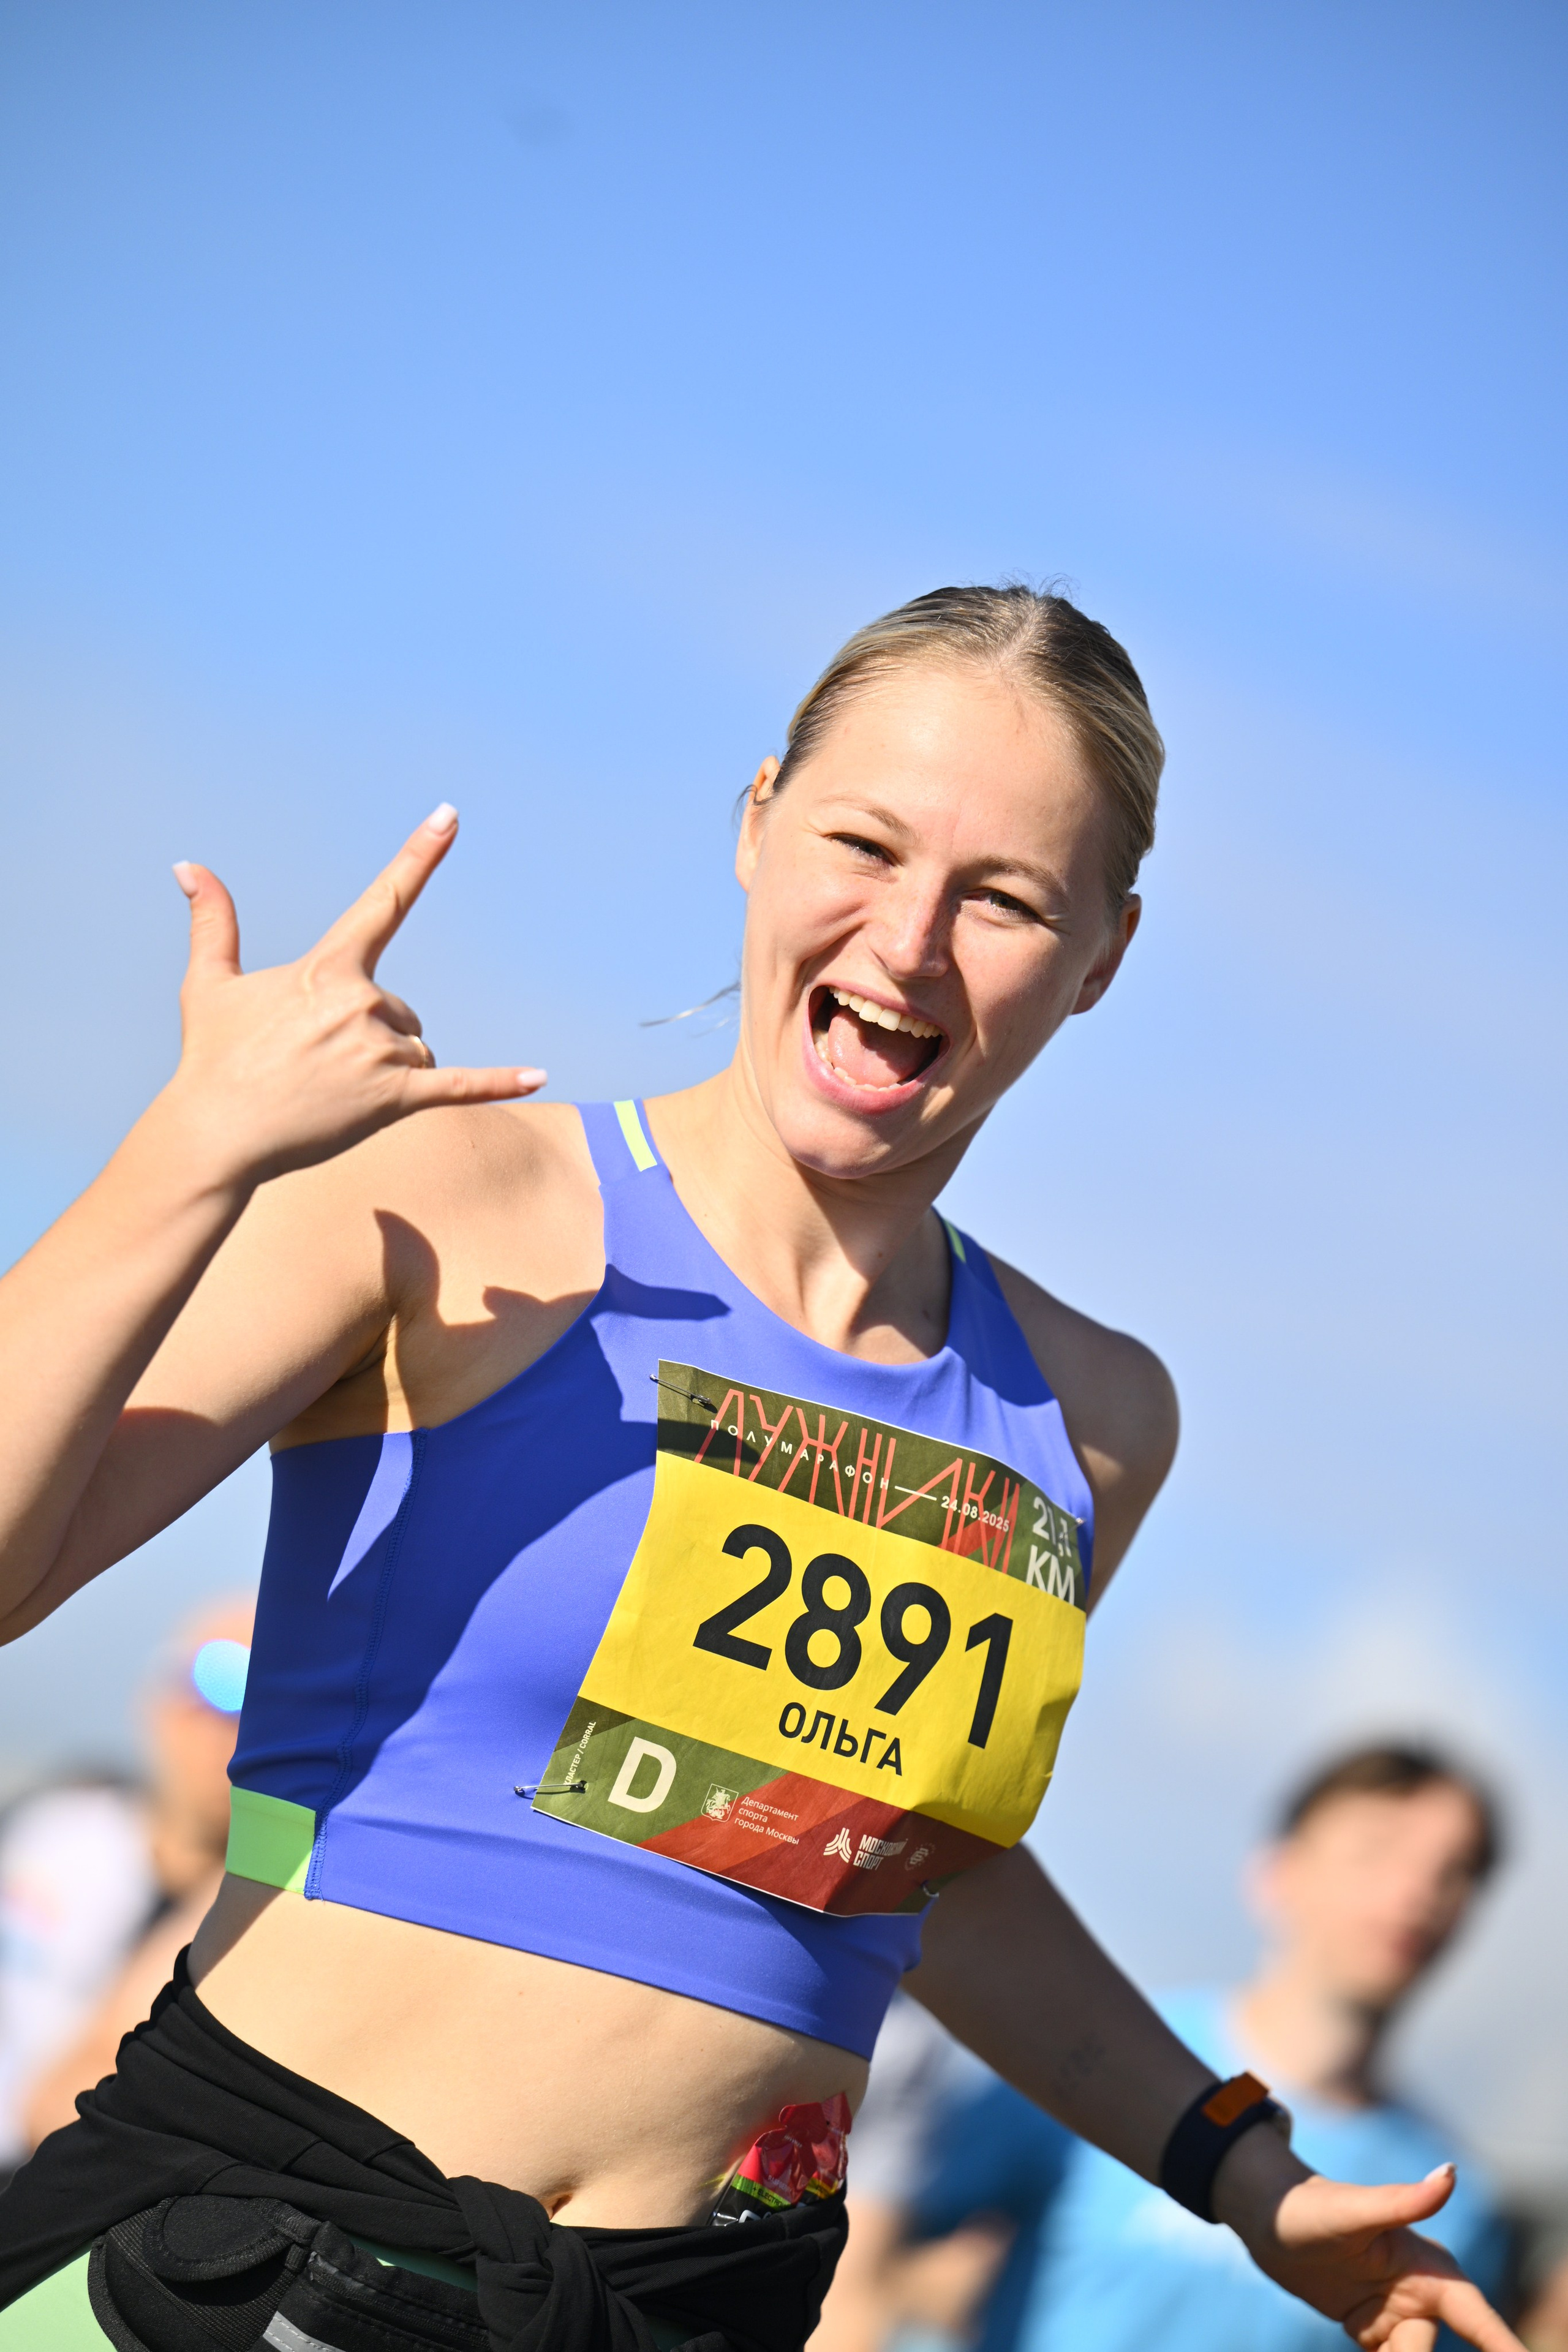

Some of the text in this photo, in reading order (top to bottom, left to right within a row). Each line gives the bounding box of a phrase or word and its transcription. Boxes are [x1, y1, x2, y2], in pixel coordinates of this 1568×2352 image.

[710, 1419, 1010, 1532] ПОЛУМАРАФОН 24.08.2025
[693, 1523, 1014, 1749] 2891
[579, 1721, 597, 1749] CORRAL
[778, 1702, 903, 1776] ОЛЬГА
[608, 1736, 677, 1813] D
[738, 1807, 768, 1823] спорта
[741, 1796, 799, 1821] Департамент
[734, 1817, 800, 1845] города Москвы
[853, 1850, 884, 1871] СПОРТ
